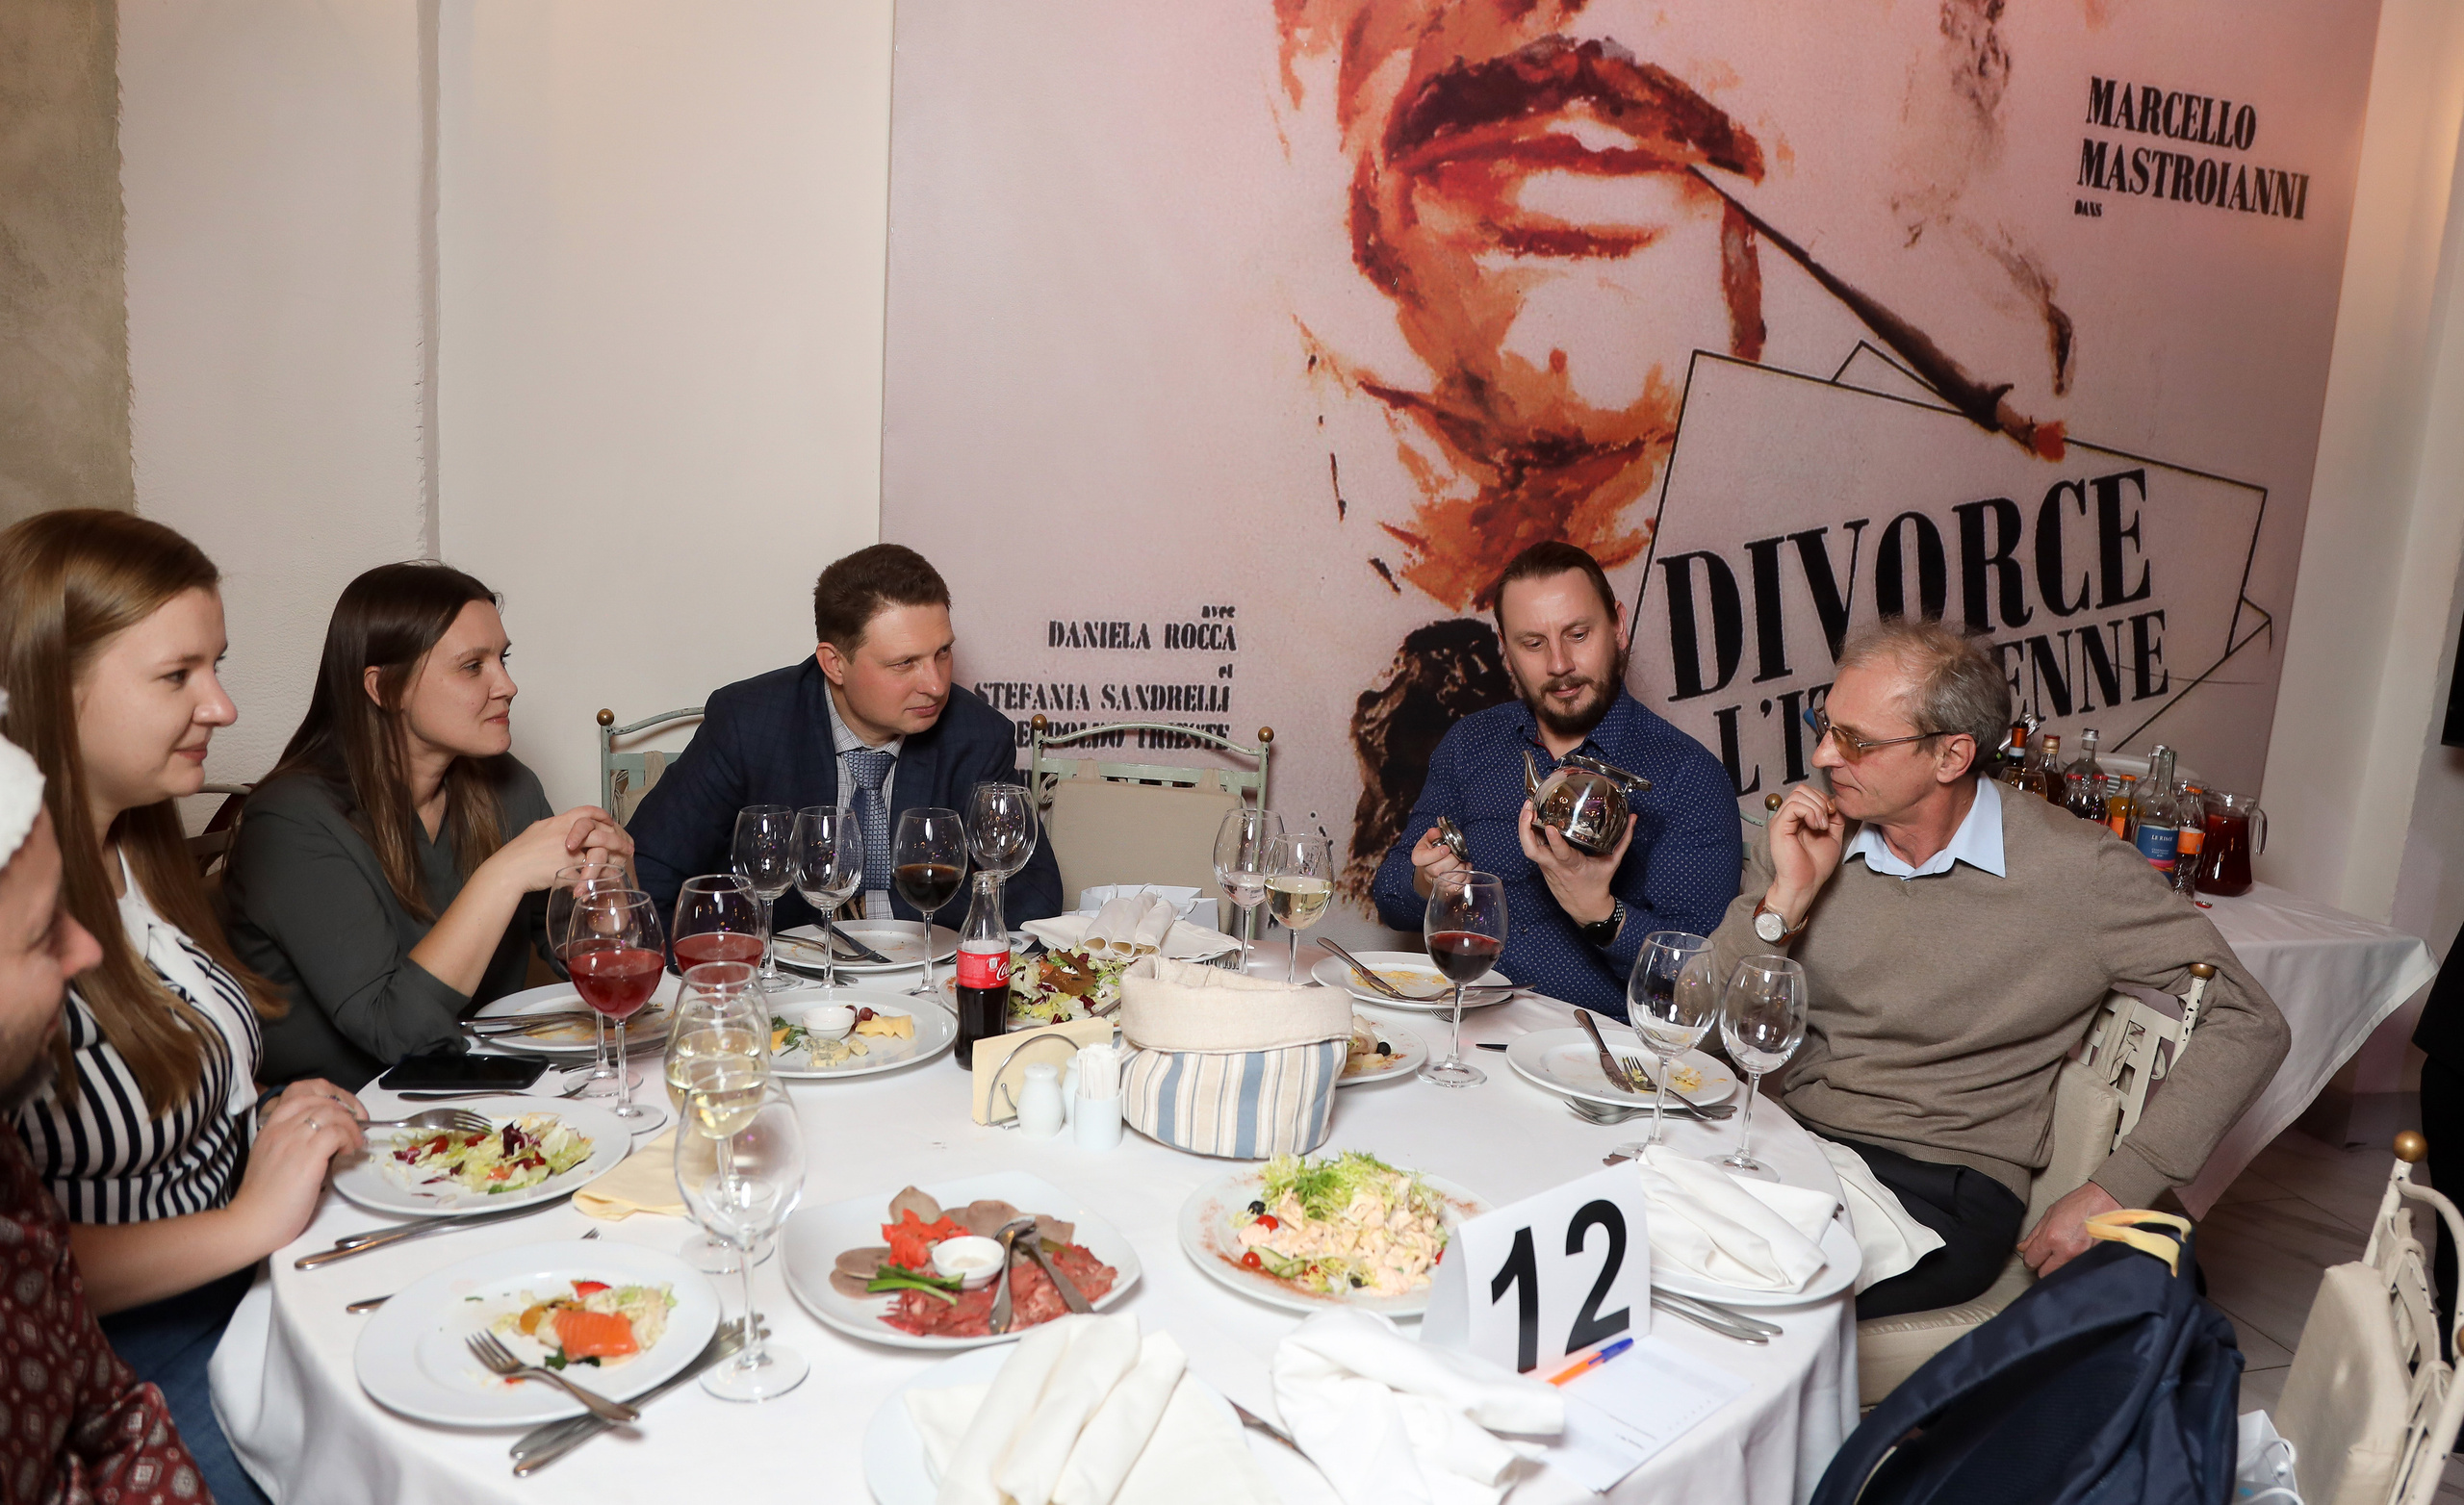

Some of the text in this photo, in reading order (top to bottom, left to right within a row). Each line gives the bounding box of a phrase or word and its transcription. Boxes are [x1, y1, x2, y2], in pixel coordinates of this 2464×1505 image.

[2086, 76, 2257, 151] MARCELLO
[2076, 138, 2309, 220] MASTROIANNI
[1656, 469, 2151, 702] DIVORCE
[1048, 621, 1237, 651] DANIELA ROCCA
[974, 682, 1230, 712] STEFANIA SANDRELLI
[1491, 1199, 1630, 1374] 12
